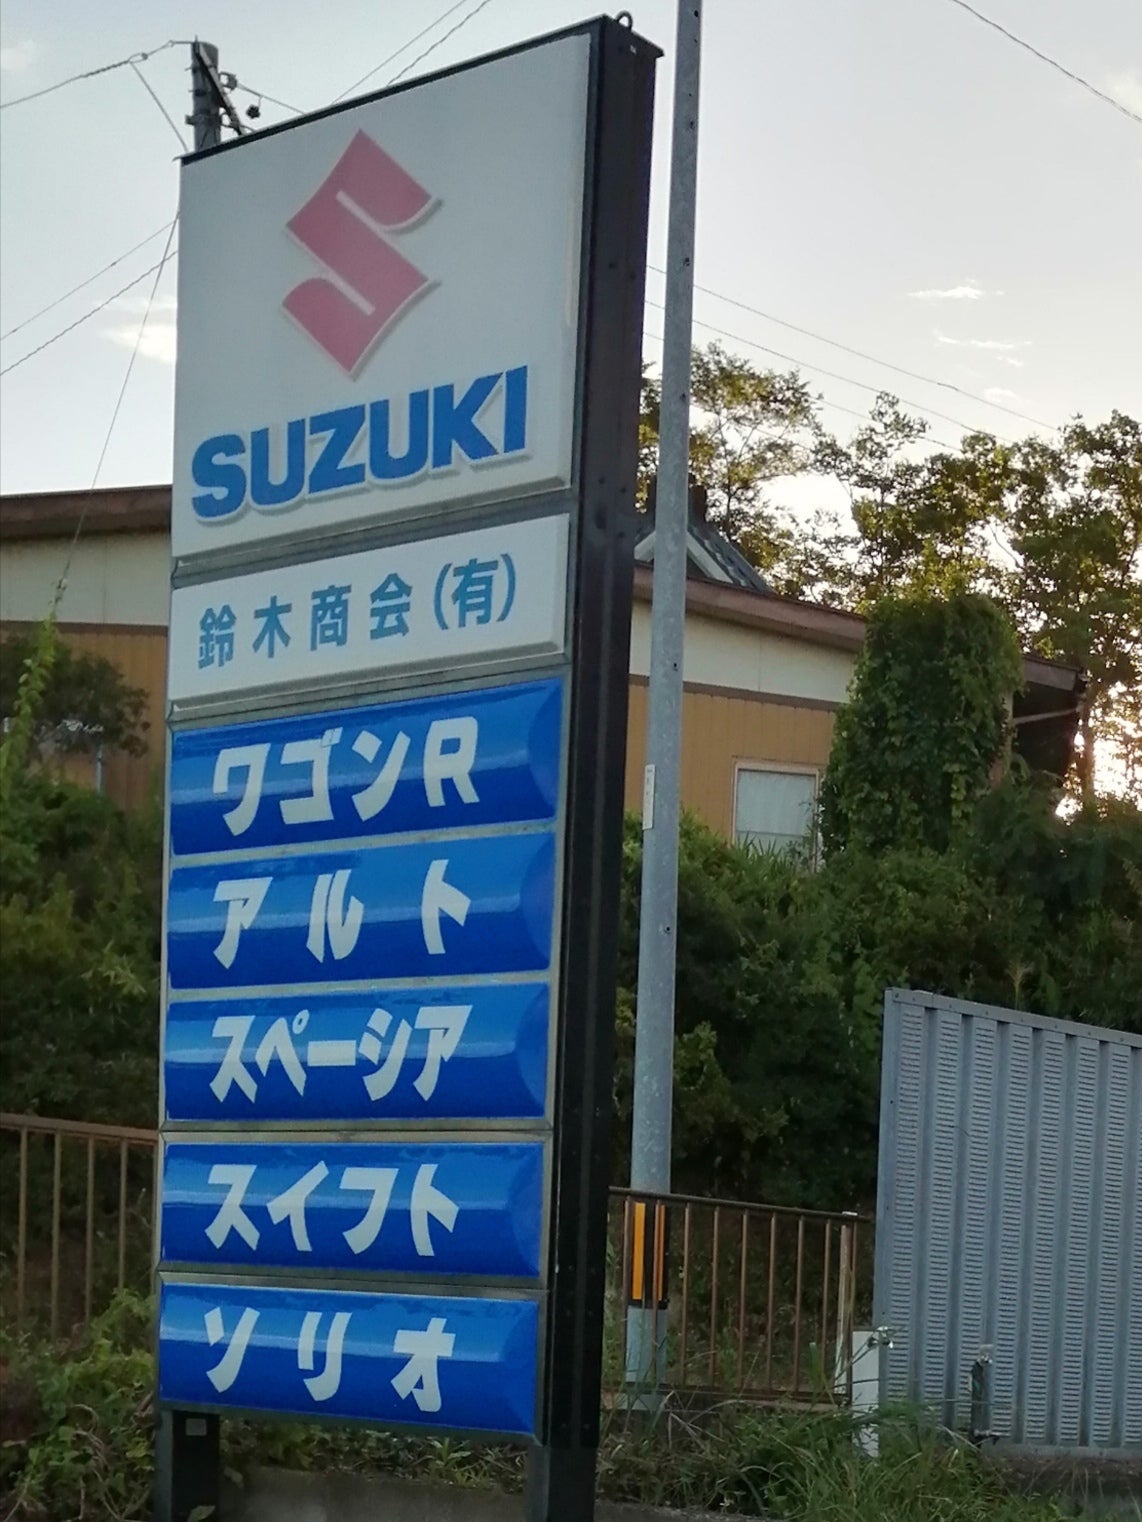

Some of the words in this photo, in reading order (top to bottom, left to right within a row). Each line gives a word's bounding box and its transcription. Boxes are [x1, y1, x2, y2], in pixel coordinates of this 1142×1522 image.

[190, 364, 530, 520] SUZUKI
[197, 552, 518, 671] 鈴木商会(有)
[211, 715, 480, 837] ワゴンR
[212, 858, 472, 970] アルト
[208, 1004, 474, 1103] スペーシア
[204, 1160, 460, 1257] スイフト
[203, 1306, 456, 1413] ソリオ
